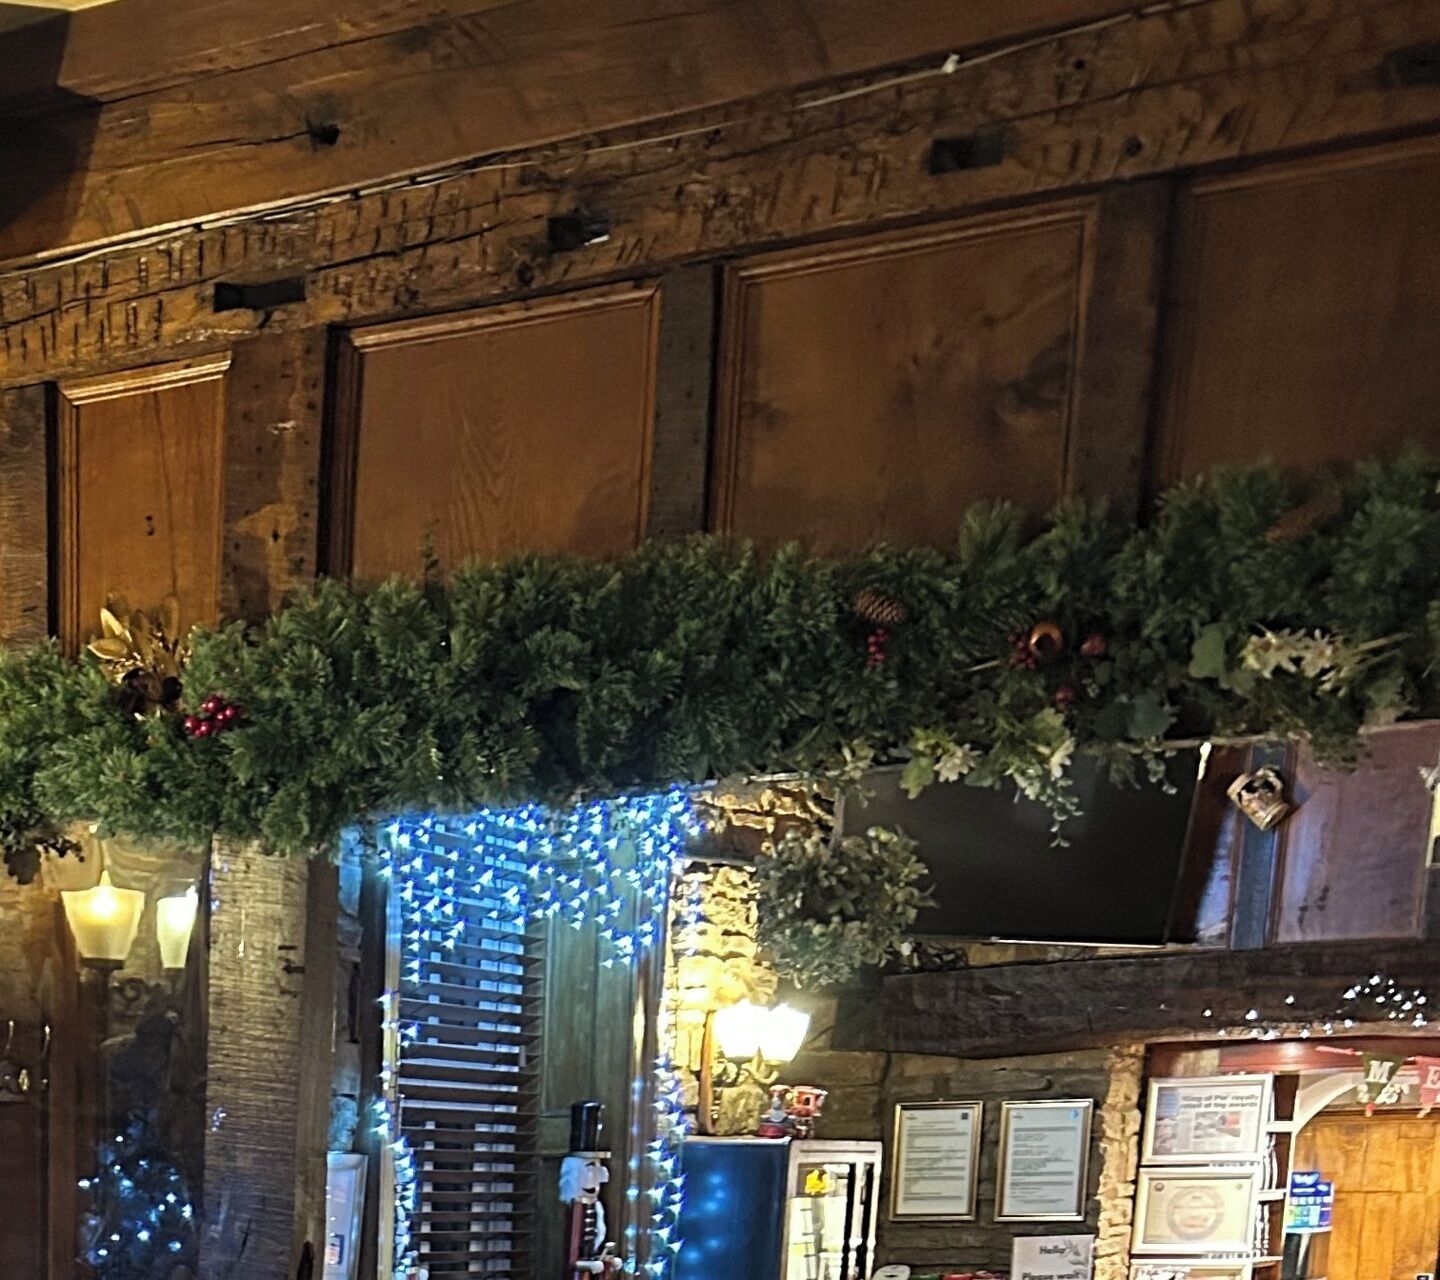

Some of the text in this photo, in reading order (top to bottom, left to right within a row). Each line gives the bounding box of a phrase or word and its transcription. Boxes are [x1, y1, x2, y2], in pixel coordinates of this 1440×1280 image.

[1039, 1245, 1067, 1255] Hello
[1022, 1272, 1079, 1280] Please wait
